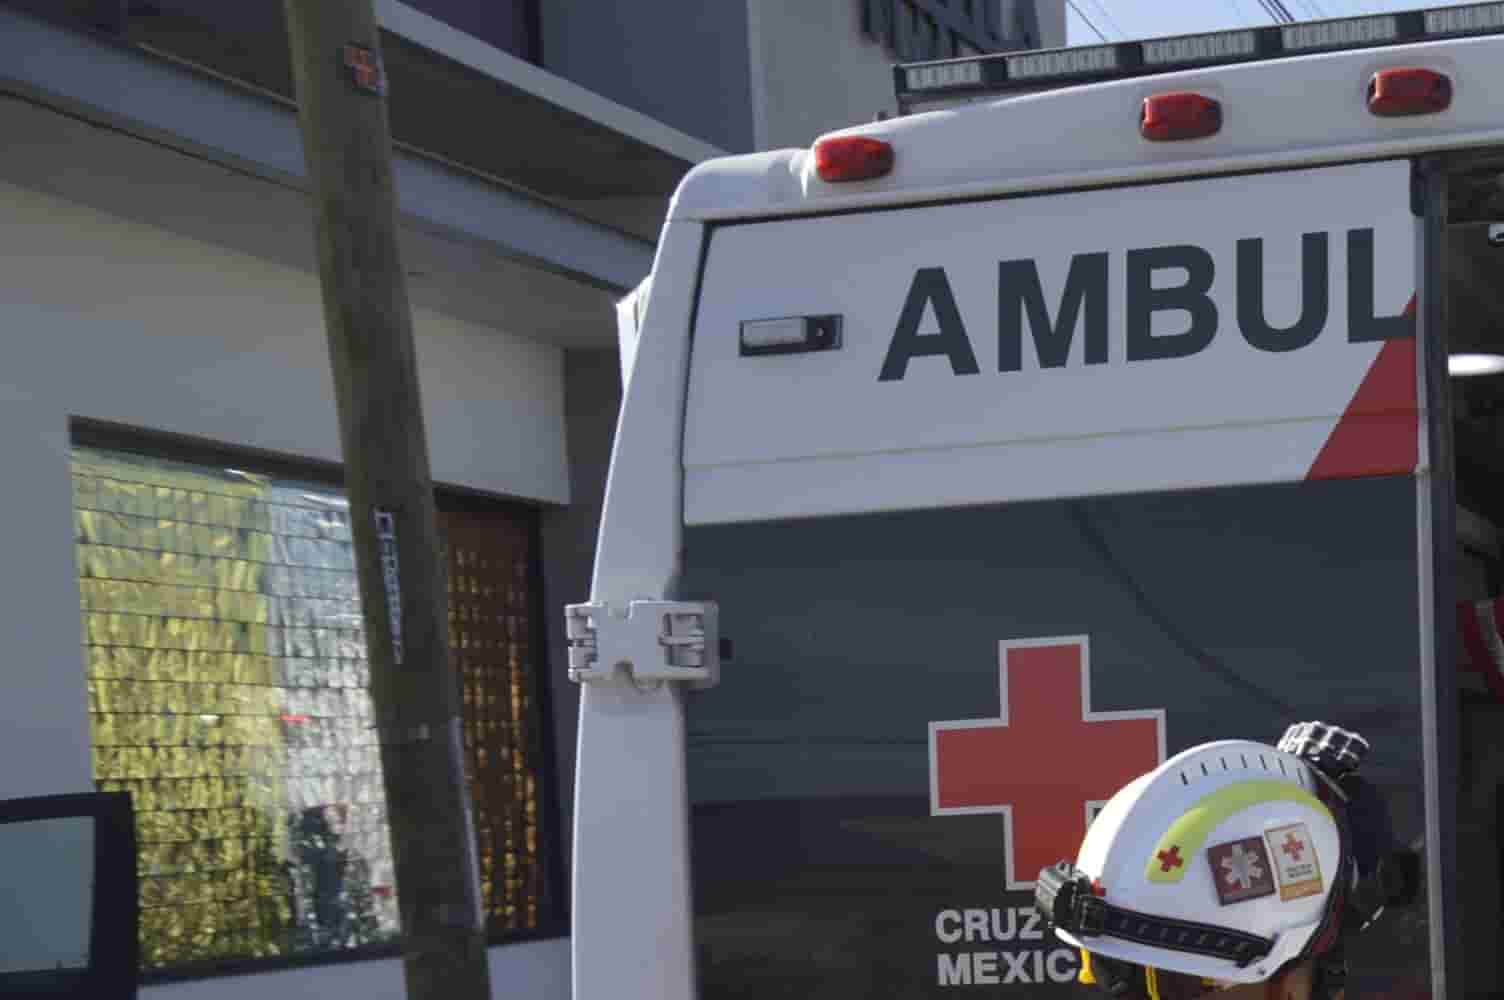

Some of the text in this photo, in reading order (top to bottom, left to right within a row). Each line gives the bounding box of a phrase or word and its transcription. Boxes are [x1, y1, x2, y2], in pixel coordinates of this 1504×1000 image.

[877, 227, 1417, 382] AMBUL
[935, 907, 1043, 943] CRUZ
[936, 949, 1076, 986] MEXIC
